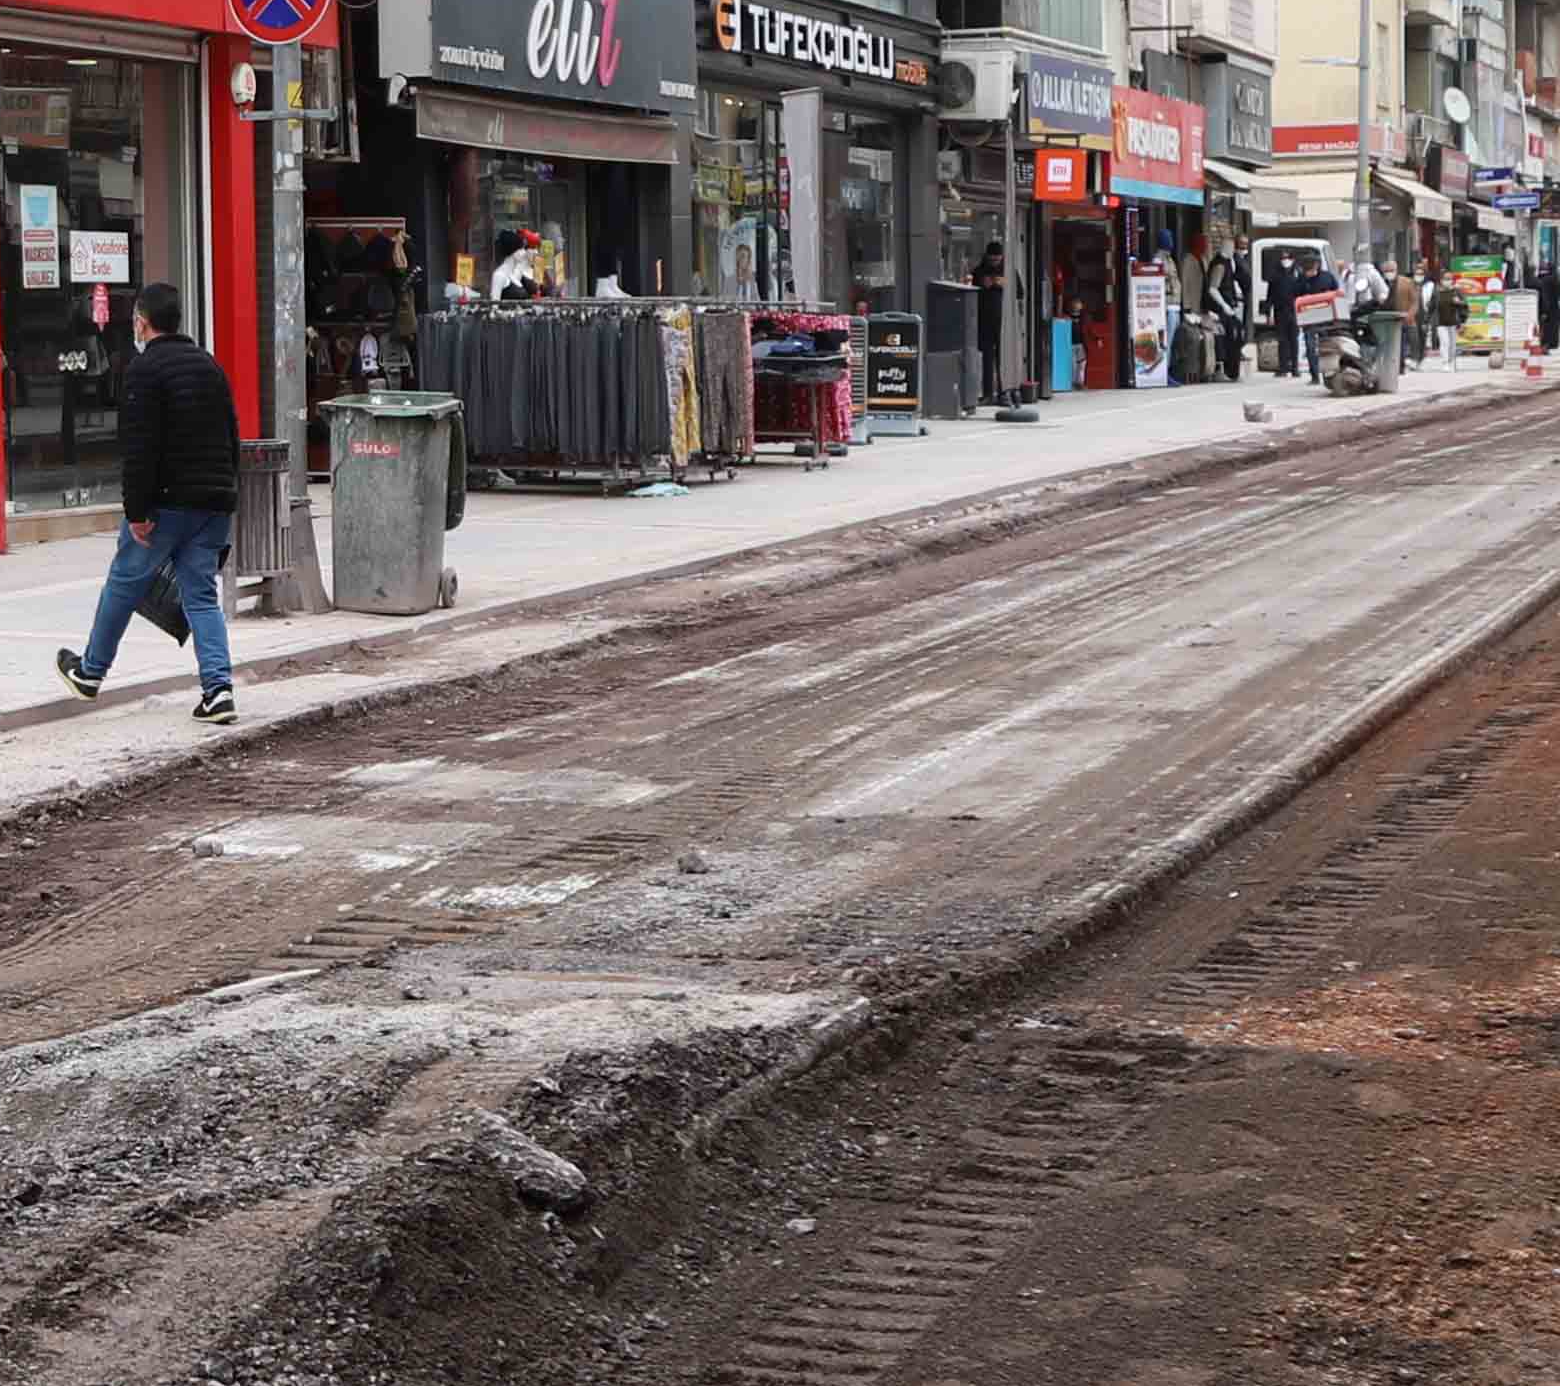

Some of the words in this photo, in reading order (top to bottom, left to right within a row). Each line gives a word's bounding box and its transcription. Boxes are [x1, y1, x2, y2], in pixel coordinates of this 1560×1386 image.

[91, 236, 129, 254] Vodafone
[91, 259, 112, 275] Evde
[352, 442, 392, 454] SULO
